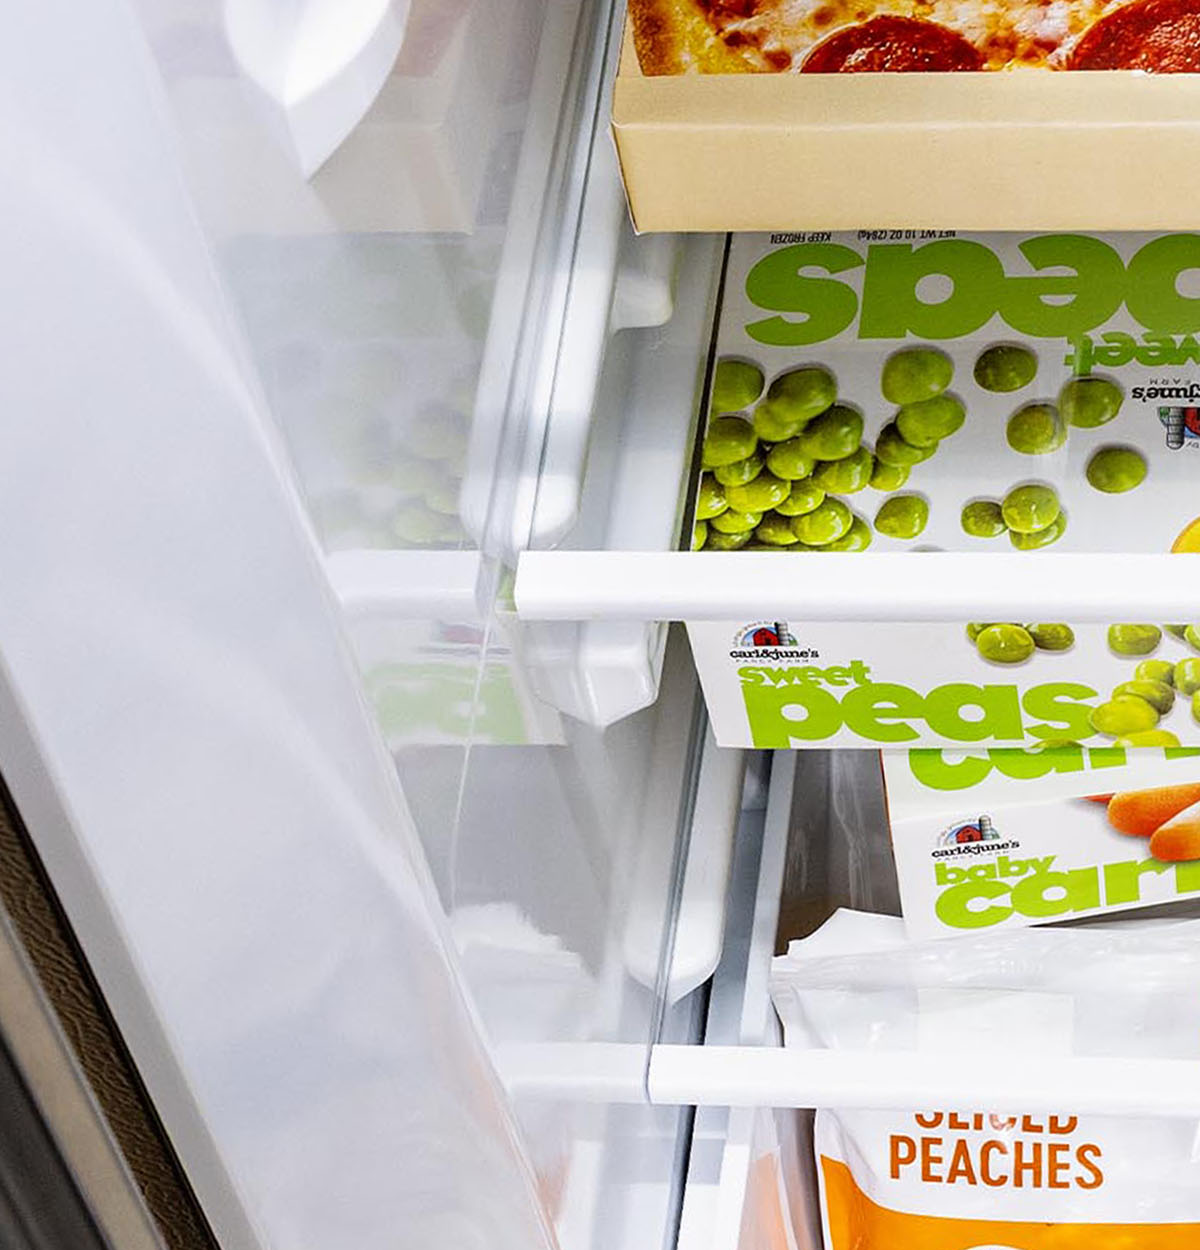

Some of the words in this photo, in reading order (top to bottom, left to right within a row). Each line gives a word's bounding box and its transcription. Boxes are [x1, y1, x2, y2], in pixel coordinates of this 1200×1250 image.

[770, 232, 805, 245] FROZEN
[808, 231, 832, 243] KEEP
[729, 648, 820, 661] carl&june's
[737, 660, 873, 687] sweet
[741, 681, 1100, 749] peas
[931, 839, 1020, 858] carl&june's
[934, 854, 1057, 886] baby
[889, 1134, 1104, 1190] PEACHES
